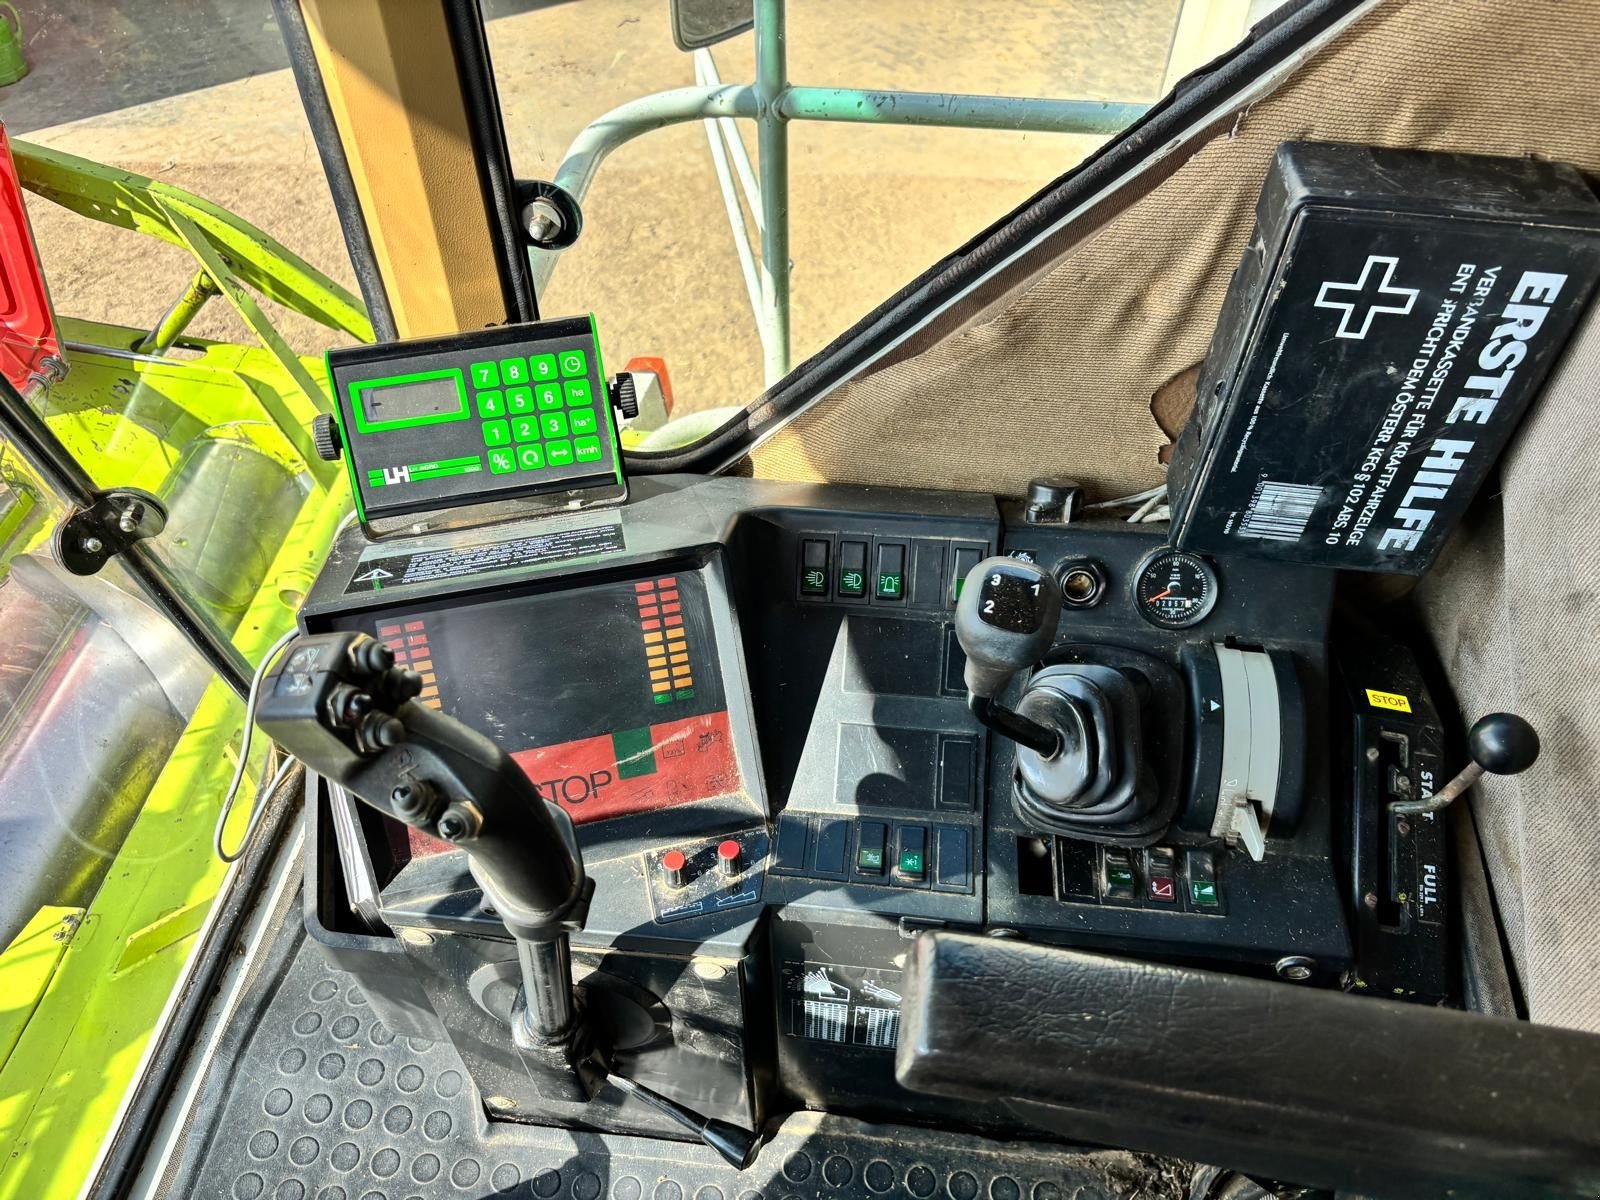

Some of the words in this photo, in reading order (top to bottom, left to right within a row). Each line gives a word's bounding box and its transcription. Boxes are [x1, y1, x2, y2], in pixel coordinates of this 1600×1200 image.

[1445, 271, 1568, 424] ERSTE
[509, 365, 520, 379] 8
[538, 361, 549, 375] 9
[1401, 359, 1429, 389] DEM
[479, 369, 489, 383] 7
[543, 390, 554, 404] 6
[571, 388, 584, 398] ha
[485, 397, 496, 411] 4
[514, 393, 525, 408] 5
[549, 419, 559, 432] 3
[1374, 392, 1415, 445] ÖSTERR.
[1401, 413, 1426, 438] FÜR
[491, 427, 500, 440] 1
[520, 422, 531, 436] 2
[577, 446, 598, 456] kmh
[1361, 448, 1384, 472] KFG
[383, 465, 411, 485] LH
[1345, 483, 1366, 504] 102
[1346, 441, 1411, 546] KRAFTFAHRZEUGE
[1377, 439, 1475, 551] HILFE
[1331, 505, 1354, 530] ABS.
[1325, 532, 1341, 544] 10
[991, 574, 1002, 586] 3
[1031, 584, 1040, 596] 1
[983, 600, 995, 613] 2
[1371, 693, 1407, 708] STOP
[1421, 770, 1435, 821] STAT
[1423, 863, 1437, 905] FULL
